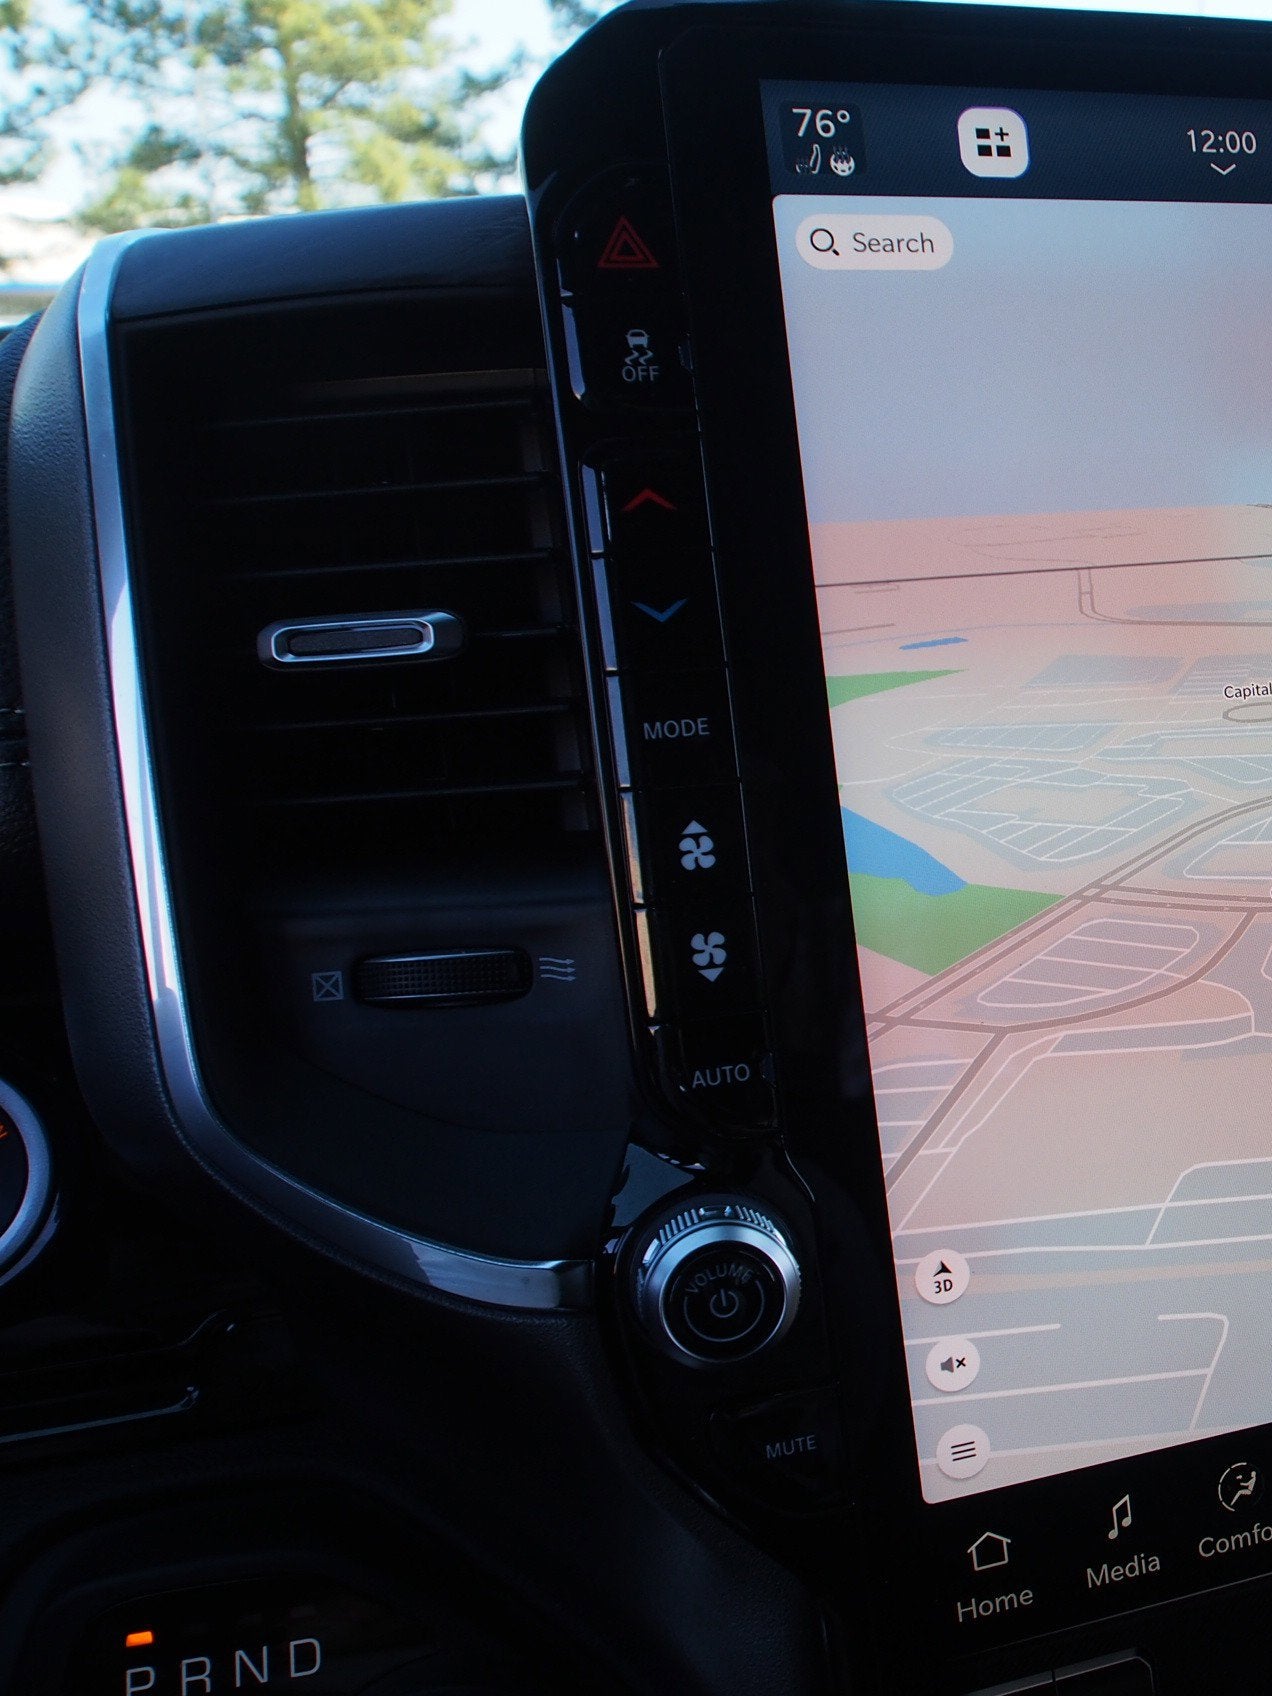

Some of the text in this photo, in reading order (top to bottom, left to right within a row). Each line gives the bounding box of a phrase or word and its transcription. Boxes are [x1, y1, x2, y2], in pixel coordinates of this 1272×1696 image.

[791, 108, 851, 138] 76°
[1186, 128, 1258, 155] 12:00
[851, 231, 935, 254] Search
[621, 365, 661, 383] OFF
[1224, 682, 1272, 701] Capital
[643, 717, 711, 741] MODE
[692, 1063, 751, 1089] AUTO
[685, 1262, 754, 1294] VOLUME
[933, 1278, 954, 1295] 3D
[765, 1434, 817, 1460] MUTE
[1086, 1552, 1161, 1589] Media
[956, 1588, 1034, 1623] Home
